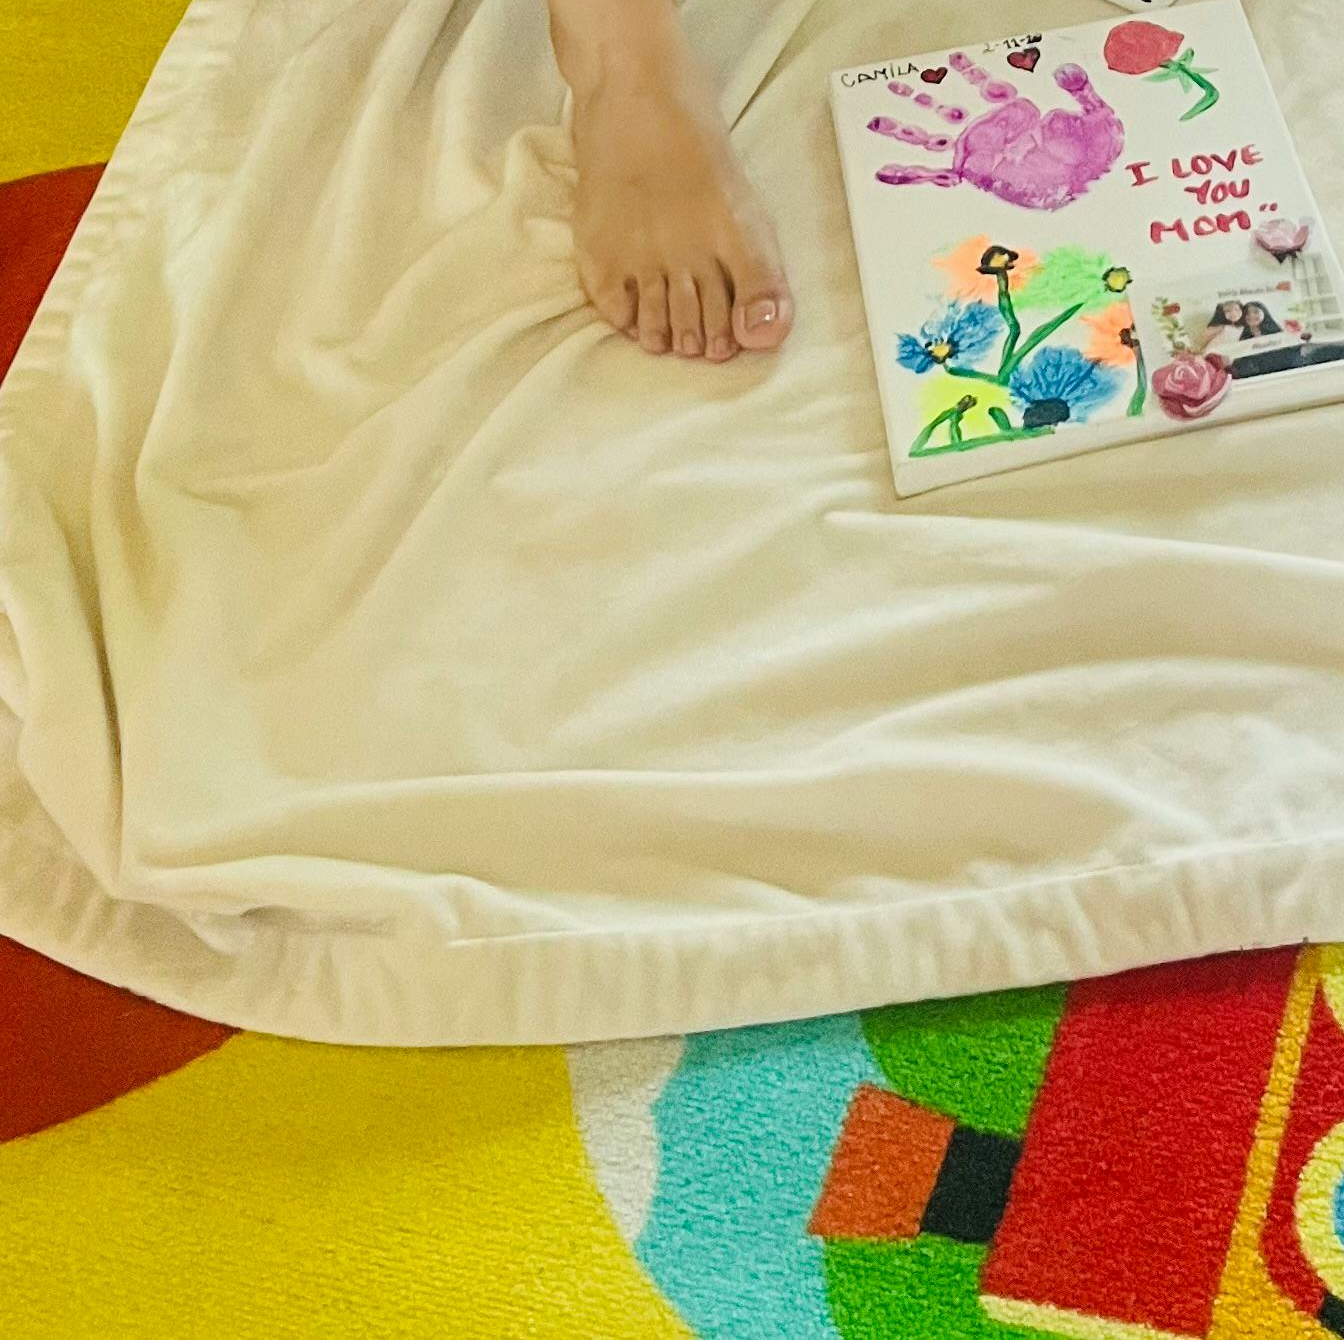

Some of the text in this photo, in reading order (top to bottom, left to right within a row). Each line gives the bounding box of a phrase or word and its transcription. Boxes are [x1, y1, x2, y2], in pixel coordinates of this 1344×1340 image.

[1124, 143, 1265, 187] I LOVE
[1183, 179, 1251, 206] YOU
